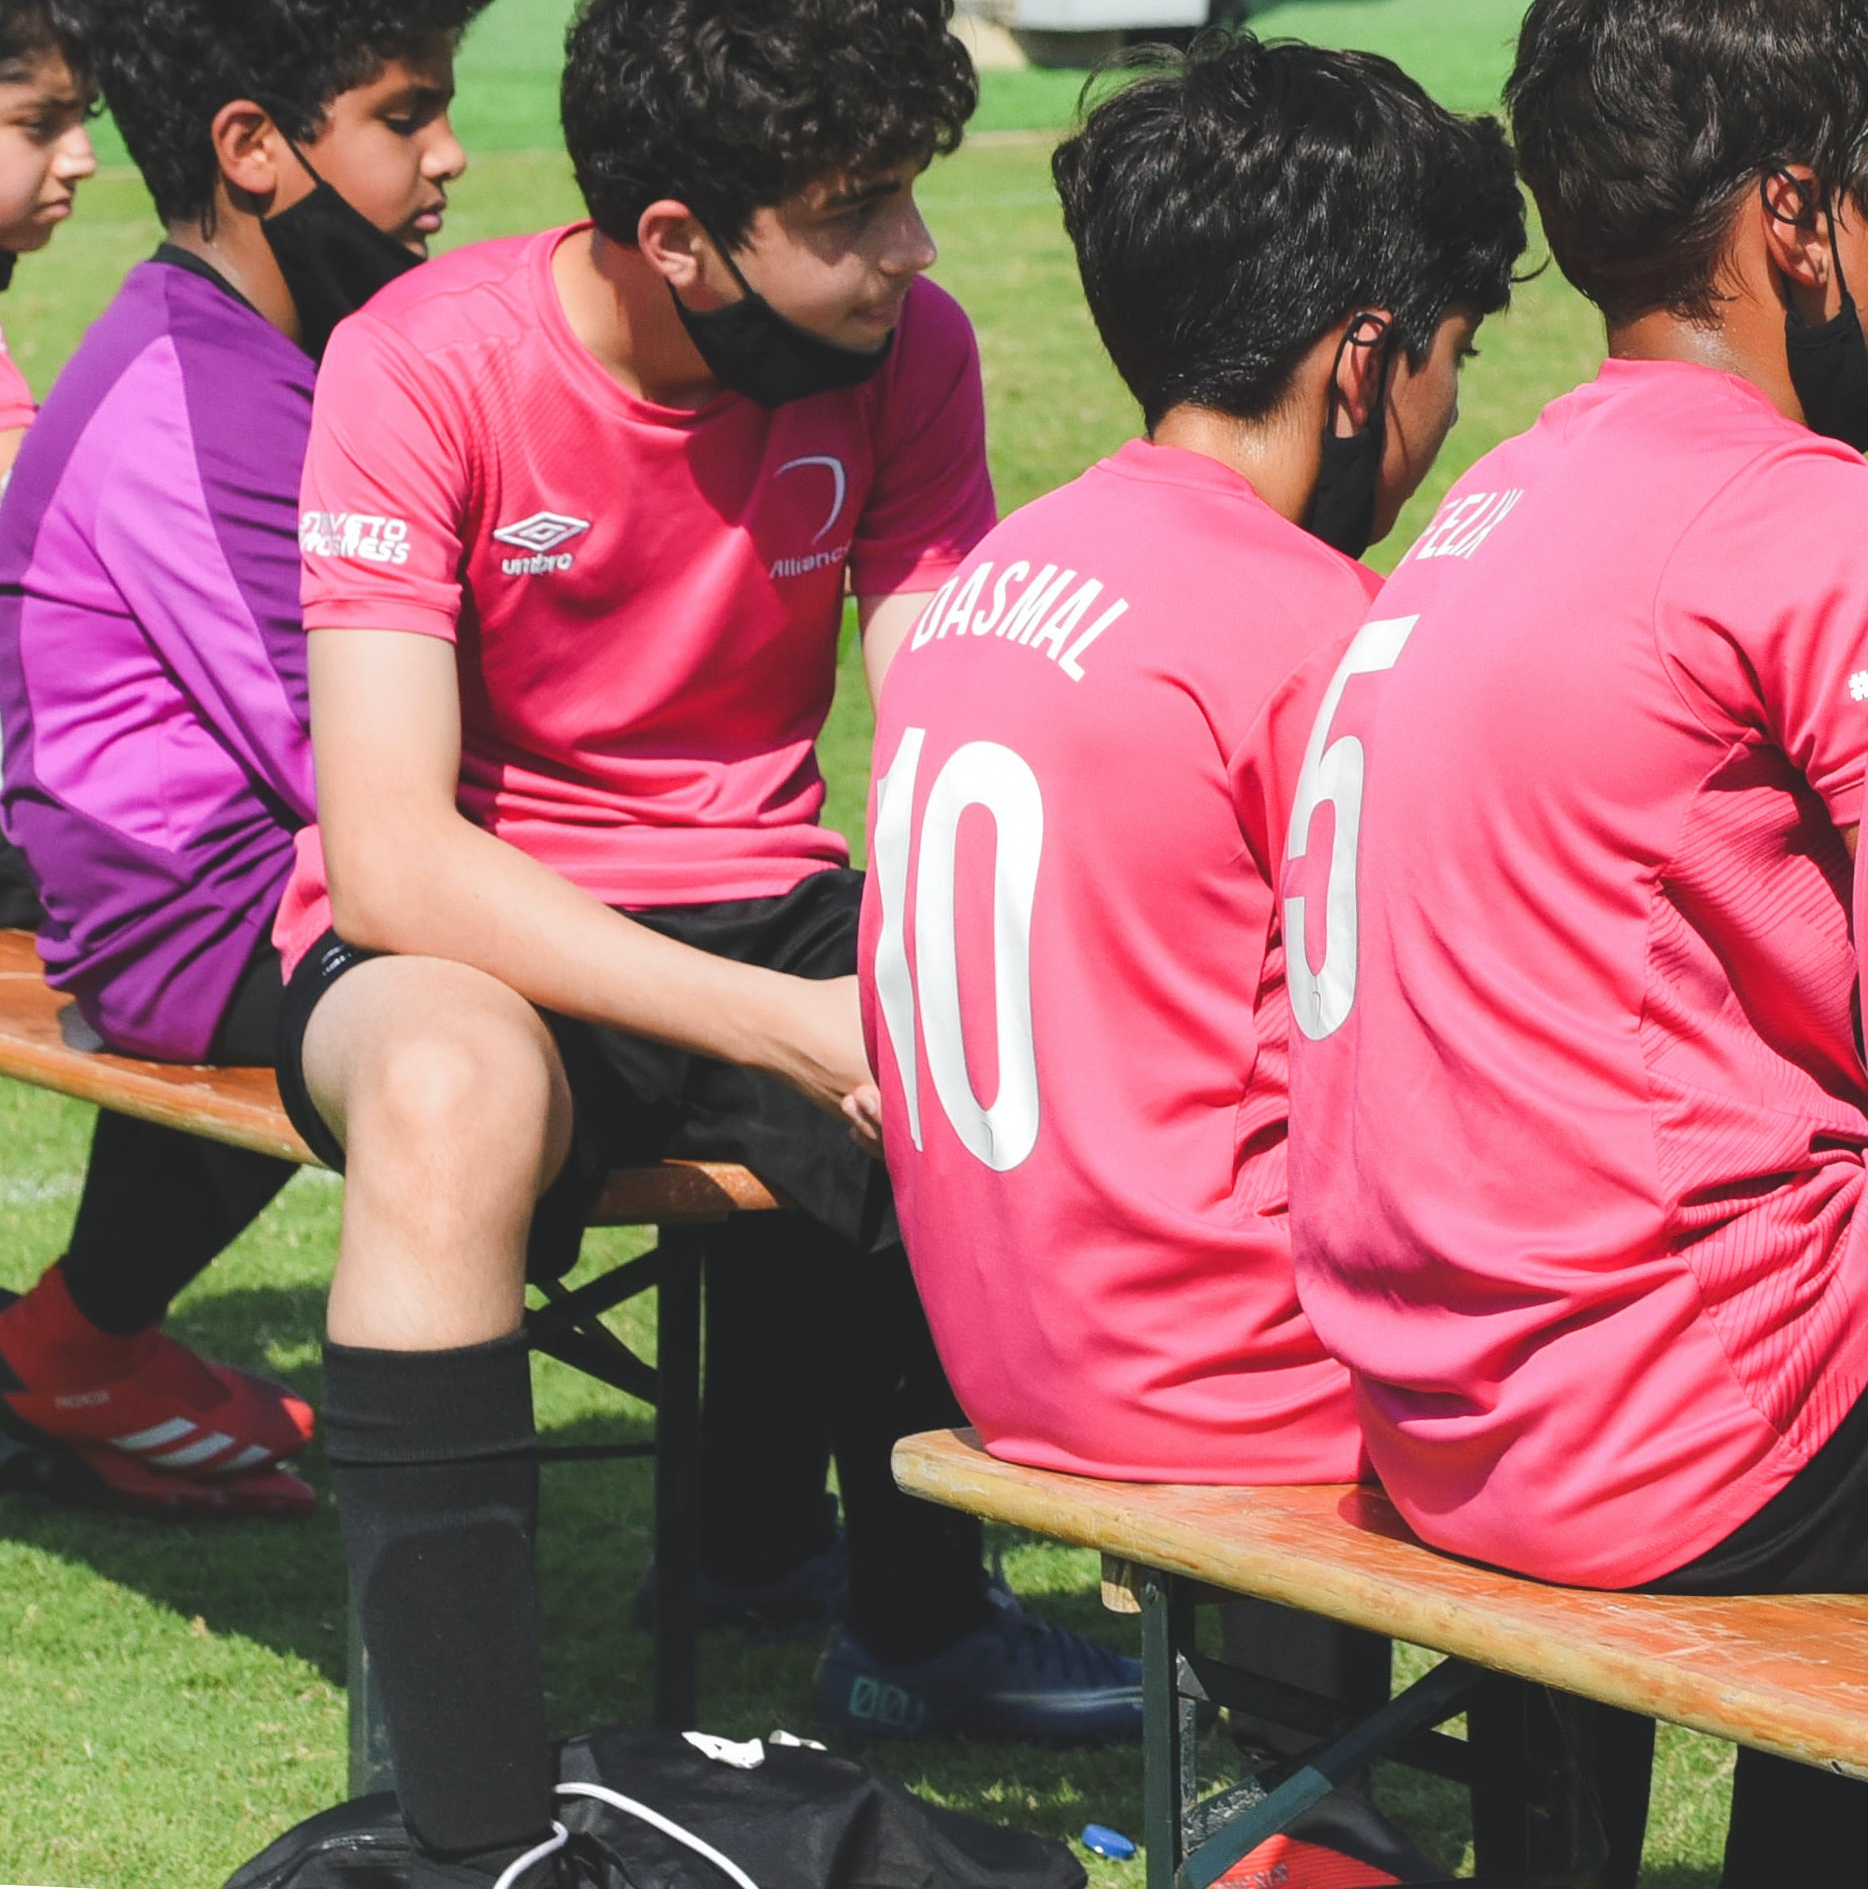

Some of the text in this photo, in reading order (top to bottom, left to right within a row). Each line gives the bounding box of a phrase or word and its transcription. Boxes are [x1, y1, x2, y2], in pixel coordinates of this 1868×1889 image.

[501, 553, 574, 575] umbro
[910, 560, 1130, 683] DASMAL
[874, 727, 1044, 1173] 10
[1284, 613, 1421, 1041] 5
